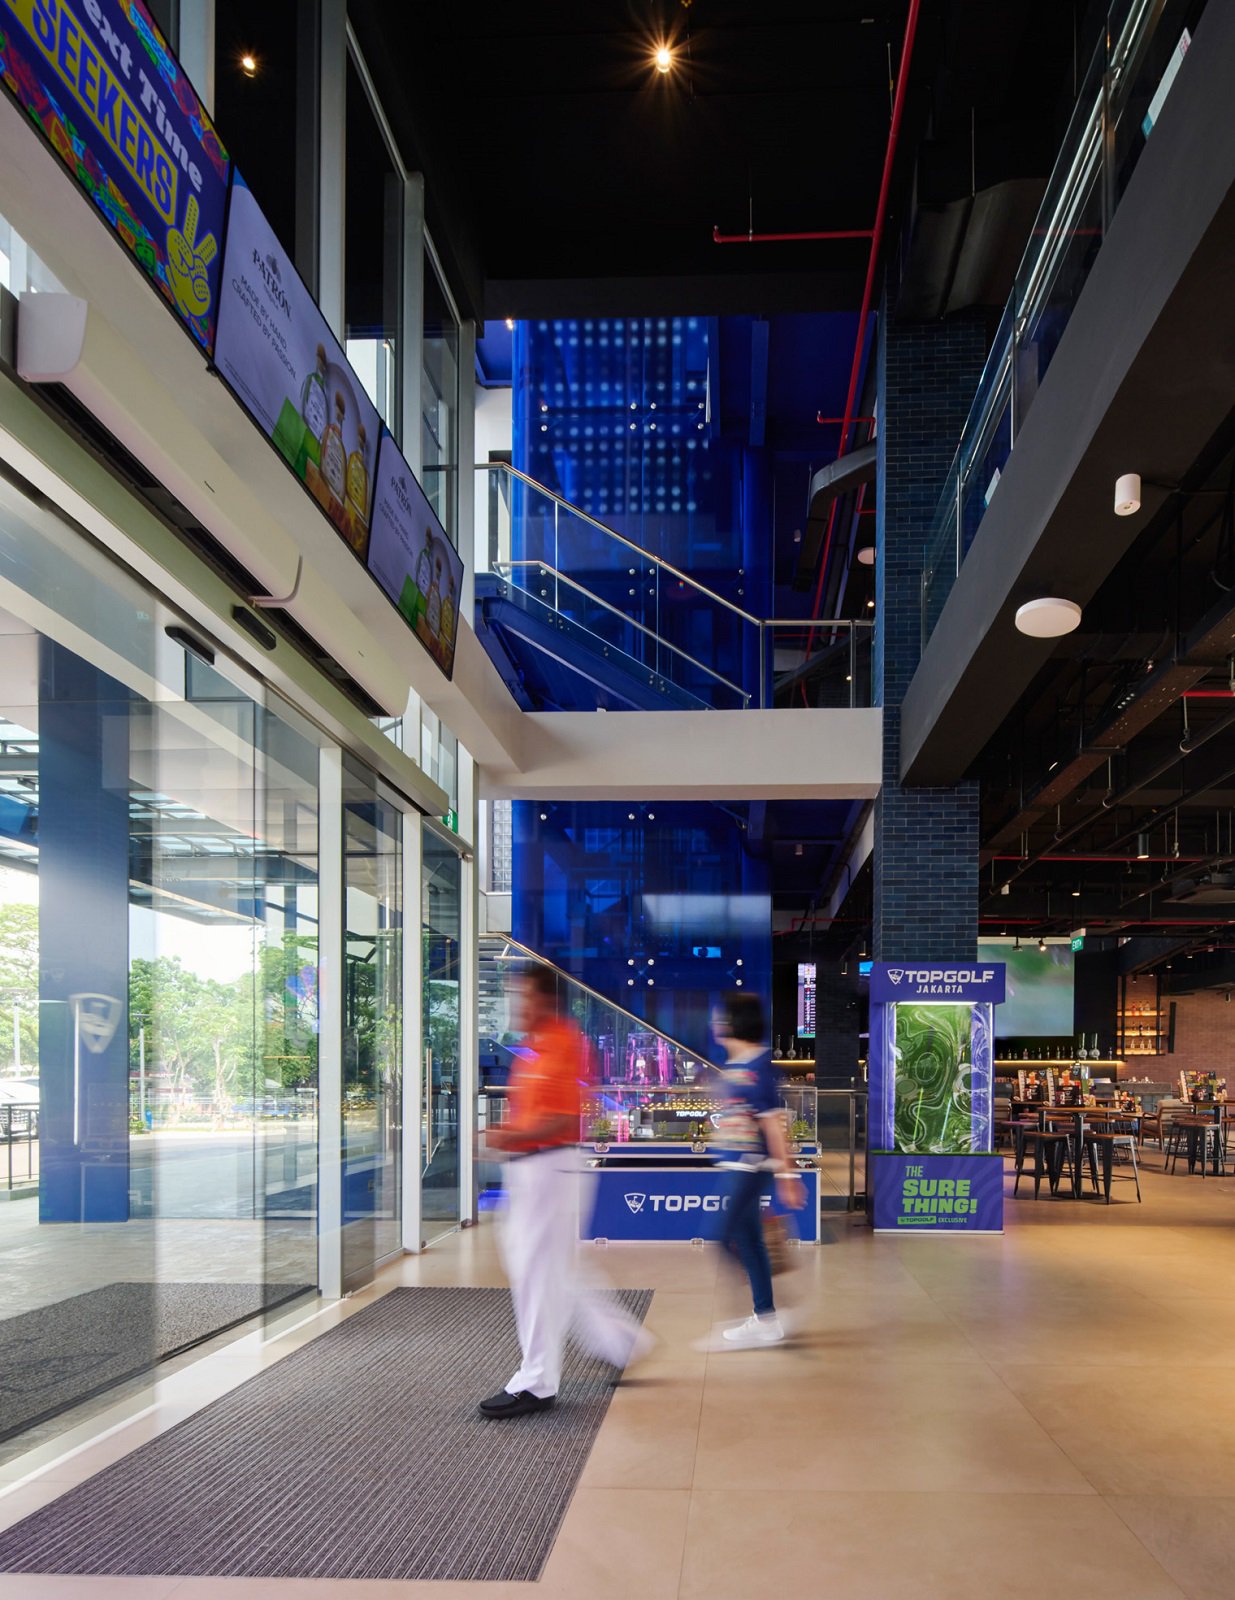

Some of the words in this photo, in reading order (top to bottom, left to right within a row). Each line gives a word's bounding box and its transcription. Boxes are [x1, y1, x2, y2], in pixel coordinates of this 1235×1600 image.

[83, 0, 133, 80] ext
[139, 68, 203, 192] Time
[32, 0, 173, 215] SEEKERS
[241, 275, 260, 308] MADE
[260, 304, 269, 320] BY
[232, 278, 262, 327] CRAFTED
[262, 324, 271, 339] BY
[905, 970, 995, 983] TOPGOLF
[916, 984, 963, 994] JAKARTA
[905, 1165, 924, 1177] THE
[902, 1179, 971, 1197] SURE
[649, 1195, 772, 1212] TOPGF
[902, 1198, 978, 1214] THING!
